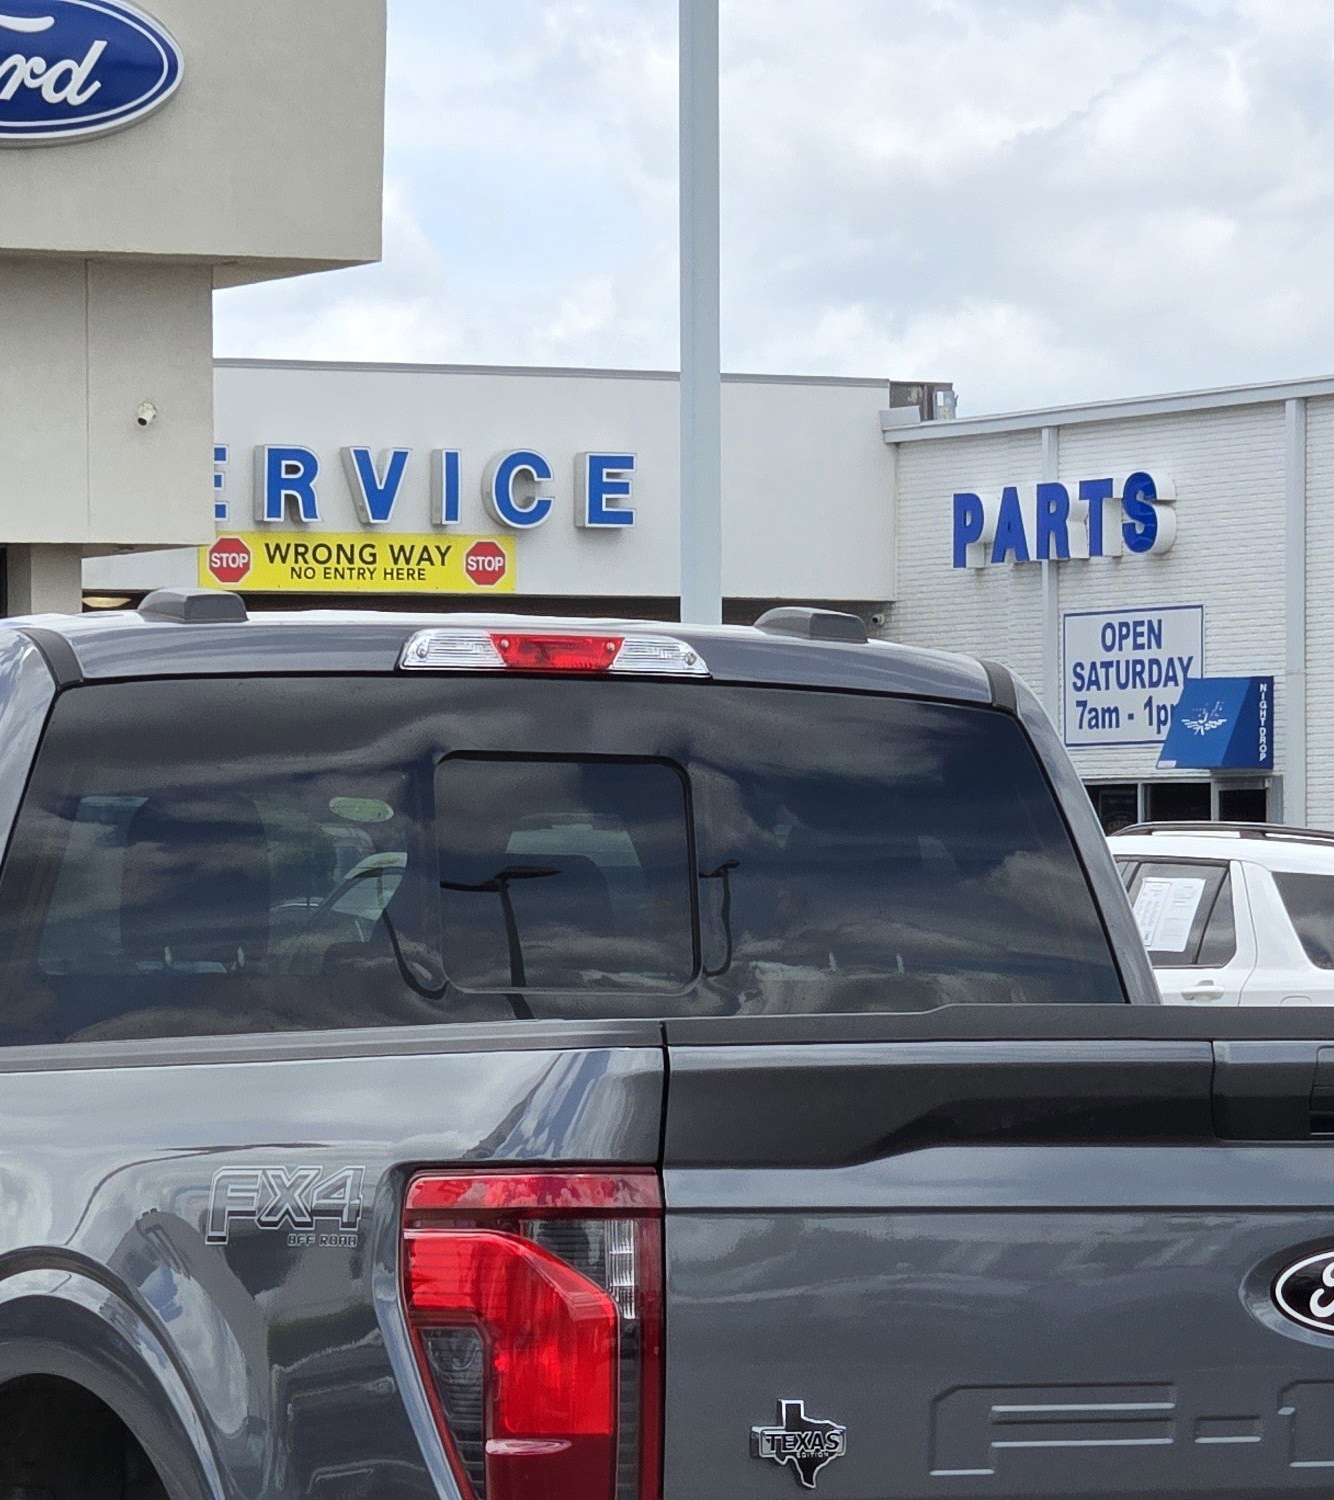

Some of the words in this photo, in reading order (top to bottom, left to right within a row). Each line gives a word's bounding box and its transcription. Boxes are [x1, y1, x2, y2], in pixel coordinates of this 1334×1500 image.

[952, 471, 1161, 569] PARTS
[210, 553, 249, 569] STOP
[264, 542, 378, 566] WRONG
[388, 544, 453, 567] WAY
[467, 555, 504, 572] STOP
[290, 566, 317, 581] NO
[323, 566, 378, 581] ENTRY
[383, 567, 427, 582] HERE
[1100, 619, 1163, 653] OPEN
[1071, 656, 1194, 693] SATURDAY
[1075, 699, 1120, 731] 7am
[1259, 683, 1268, 727] NIGHT
[1259, 727, 1268, 762] DROP
[205, 1165, 366, 1246] FX4
[287, 1233, 316, 1246] OFF
[318, 1233, 358, 1248] ROAD
[763, 1431, 841, 1452] TEXAS
